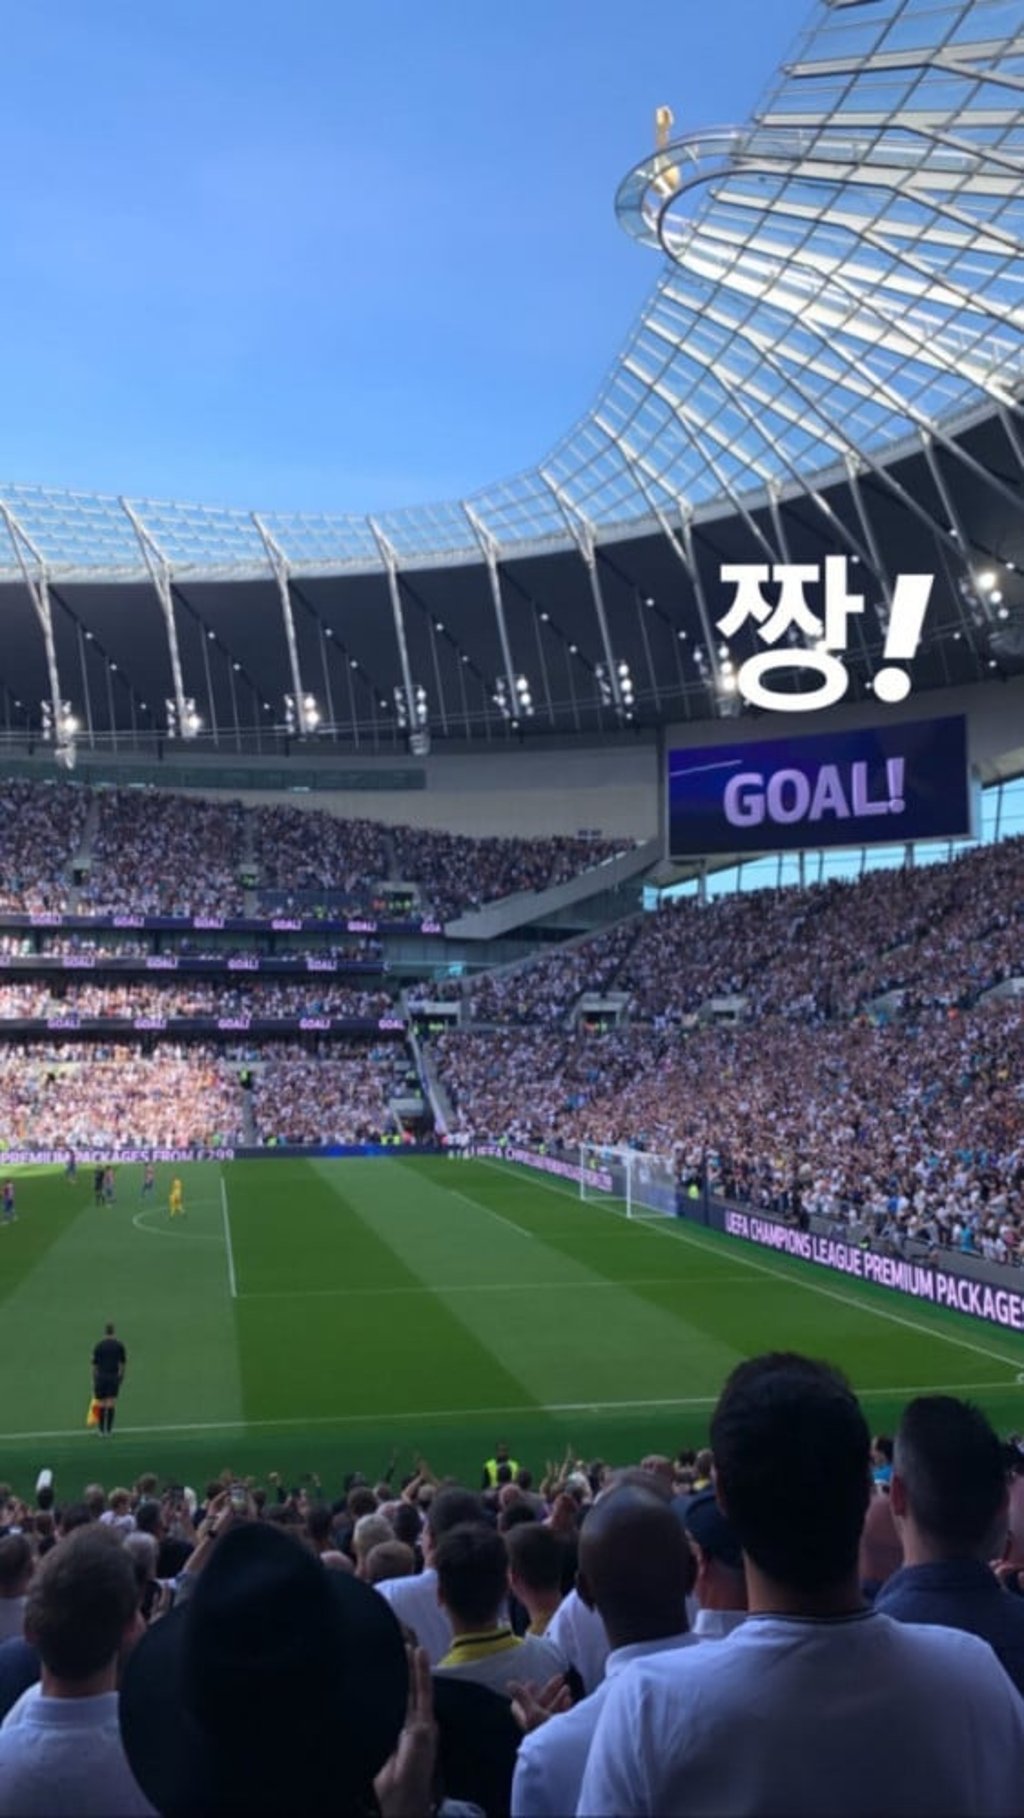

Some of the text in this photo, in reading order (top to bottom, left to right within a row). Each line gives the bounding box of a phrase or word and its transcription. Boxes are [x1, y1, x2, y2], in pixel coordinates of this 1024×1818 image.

[723, 757, 906, 827] GOAL!
[218, 1018, 250, 1029] GOAL!
[299, 1018, 331, 1029] GOAL!
[725, 1210, 750, 1238] UEFA
[750, 1218, 812, 1260] CHAMPIONS
[812, 1235, 863, 1276] LEAGUE
[863, 1251, 935, 1301] PREMIUM
